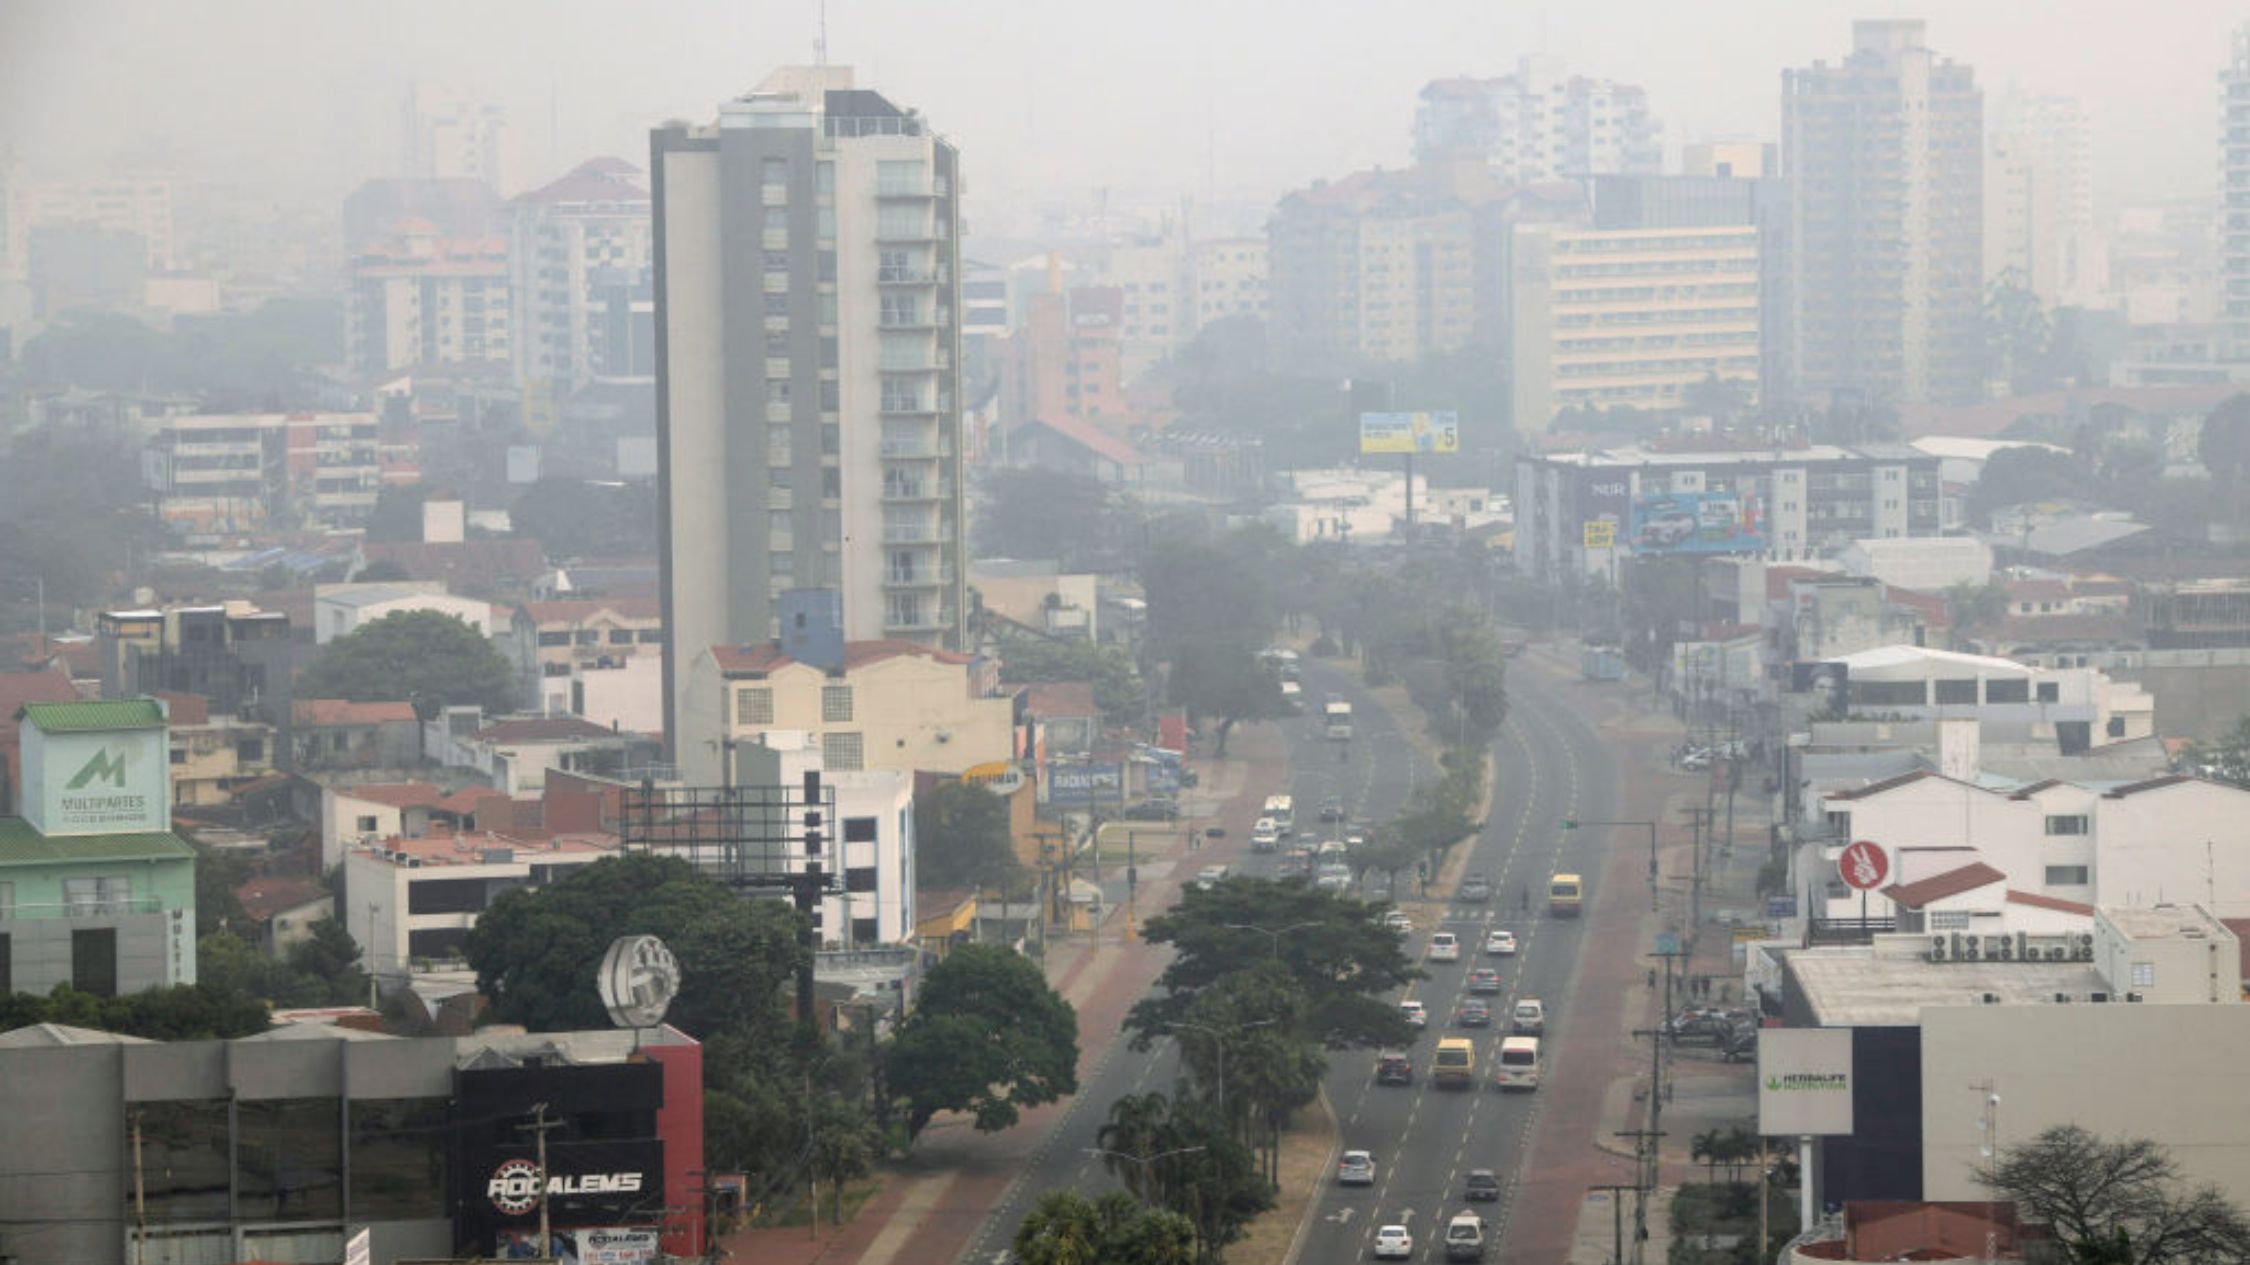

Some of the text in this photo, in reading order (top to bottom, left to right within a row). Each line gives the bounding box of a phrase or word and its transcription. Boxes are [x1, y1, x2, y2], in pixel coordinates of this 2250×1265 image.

[1444, 427, 1455, 447] 5
[1592, 482, 1625, 496] NUR
[61, 795, 144, 811] MULTIPARTES
[1783, 1073, 1846, 1082] HERBALIFE
[487, 1171, 643, 1198] ROCALEMS
